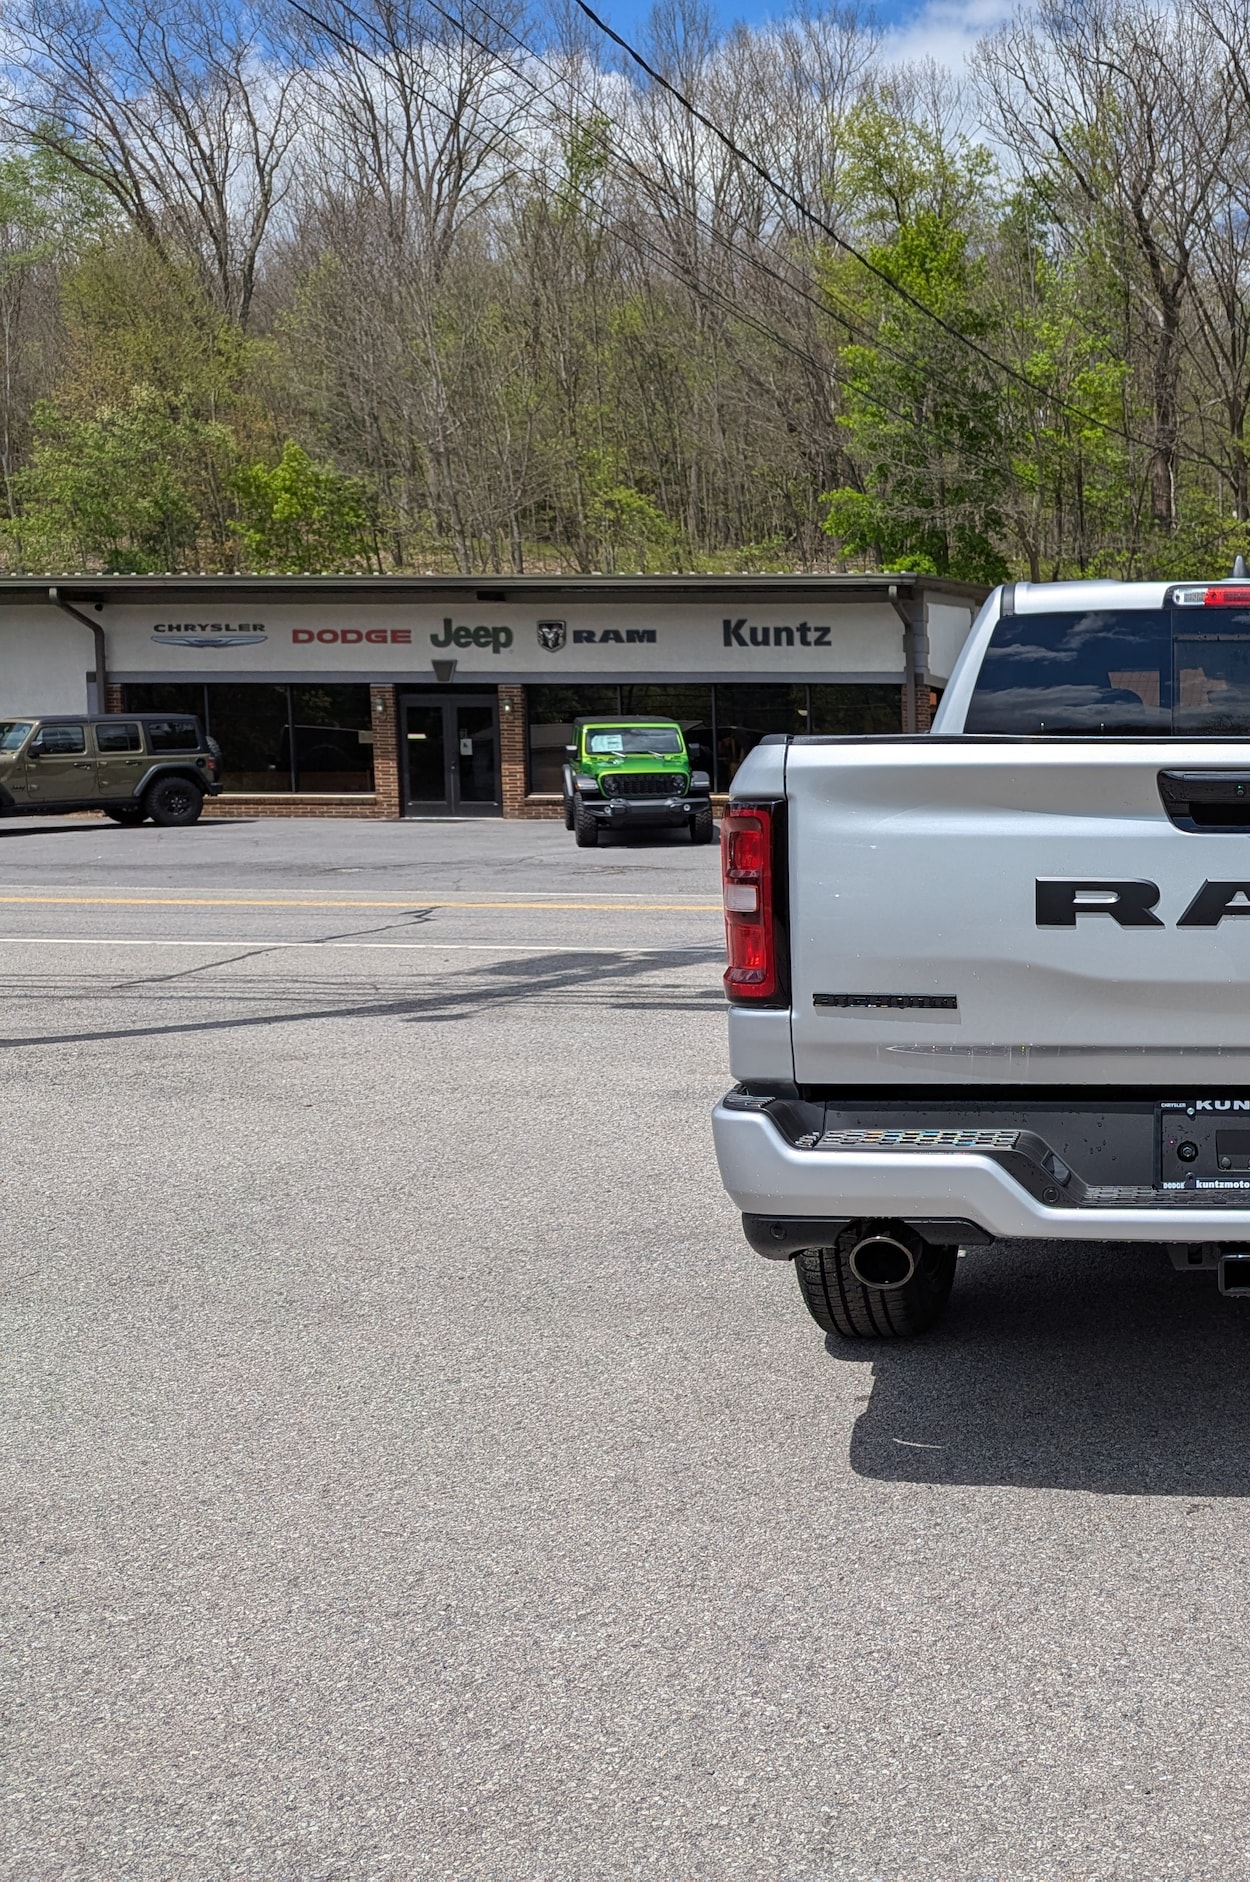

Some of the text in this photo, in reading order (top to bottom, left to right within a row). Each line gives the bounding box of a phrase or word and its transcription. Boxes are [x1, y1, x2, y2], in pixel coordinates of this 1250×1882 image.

[153, 623, 266, 633] CHRYSLER
[430, 617, 513, 654] Jeep
[722, 618, 832, 648] Kuntz
[291, 629, 412, 644] DODGE
[572, 629, 657, 644] RAM
